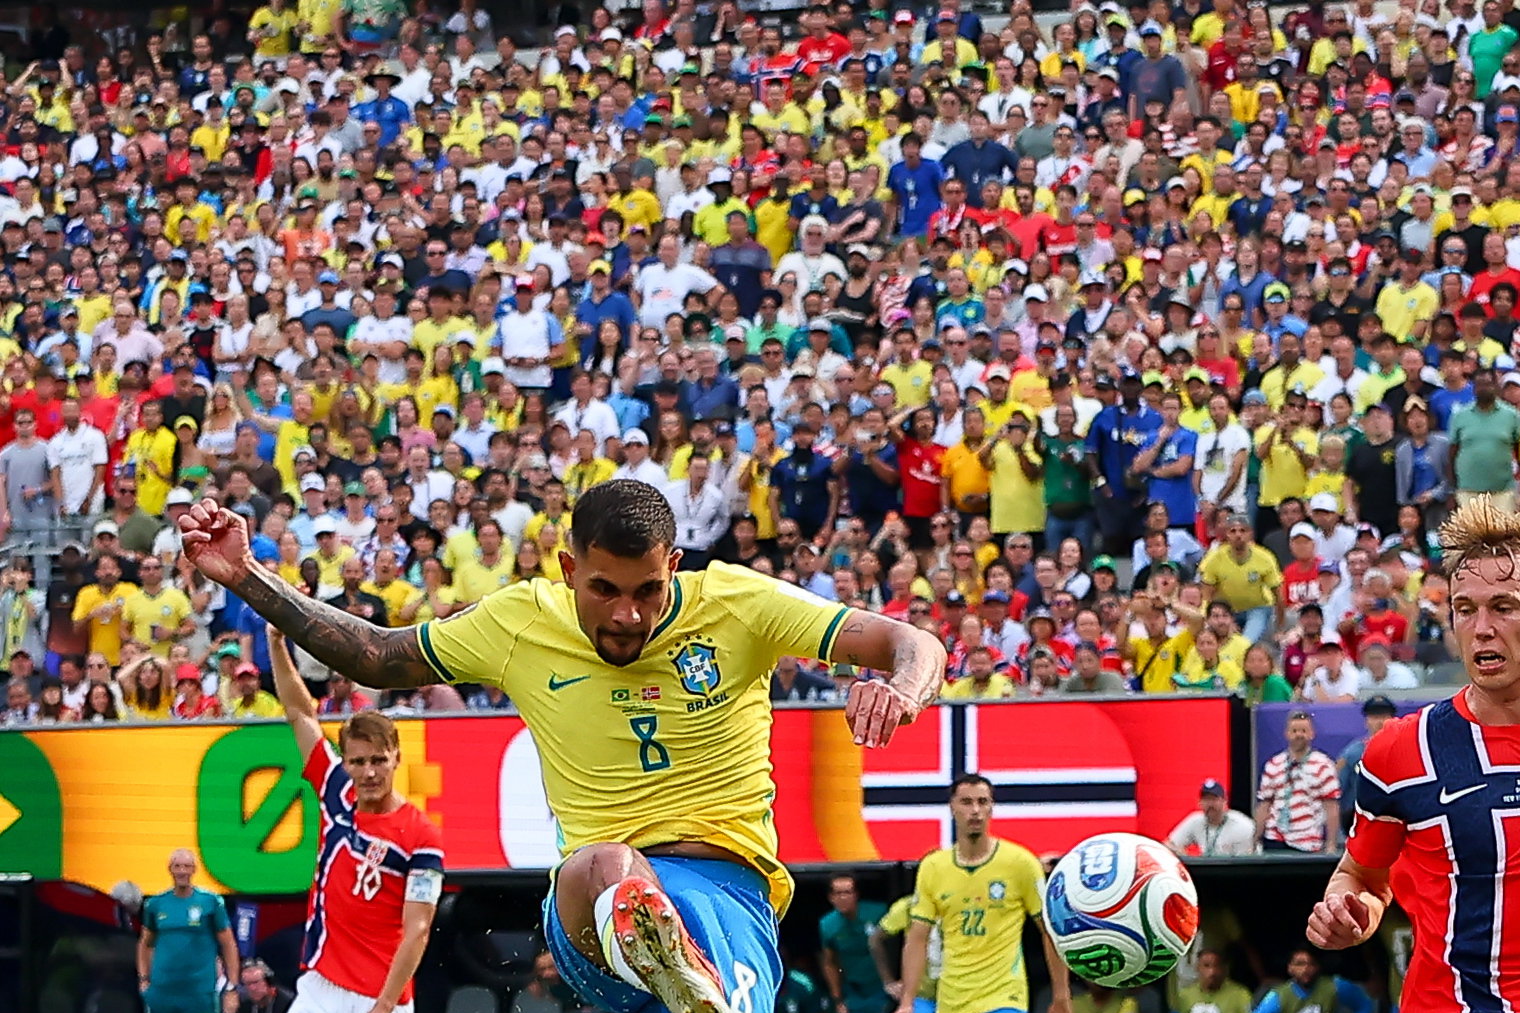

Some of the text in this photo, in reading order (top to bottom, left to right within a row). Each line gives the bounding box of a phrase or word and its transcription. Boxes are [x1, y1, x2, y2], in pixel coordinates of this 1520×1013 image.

[689, 664, 706, 674] CBF
[686, 692, 731, 713] BRASIL
[629, 715, 671, 773] 8
[352, 861, 382, 901] 10
[961, 909, 986, 936] 22
